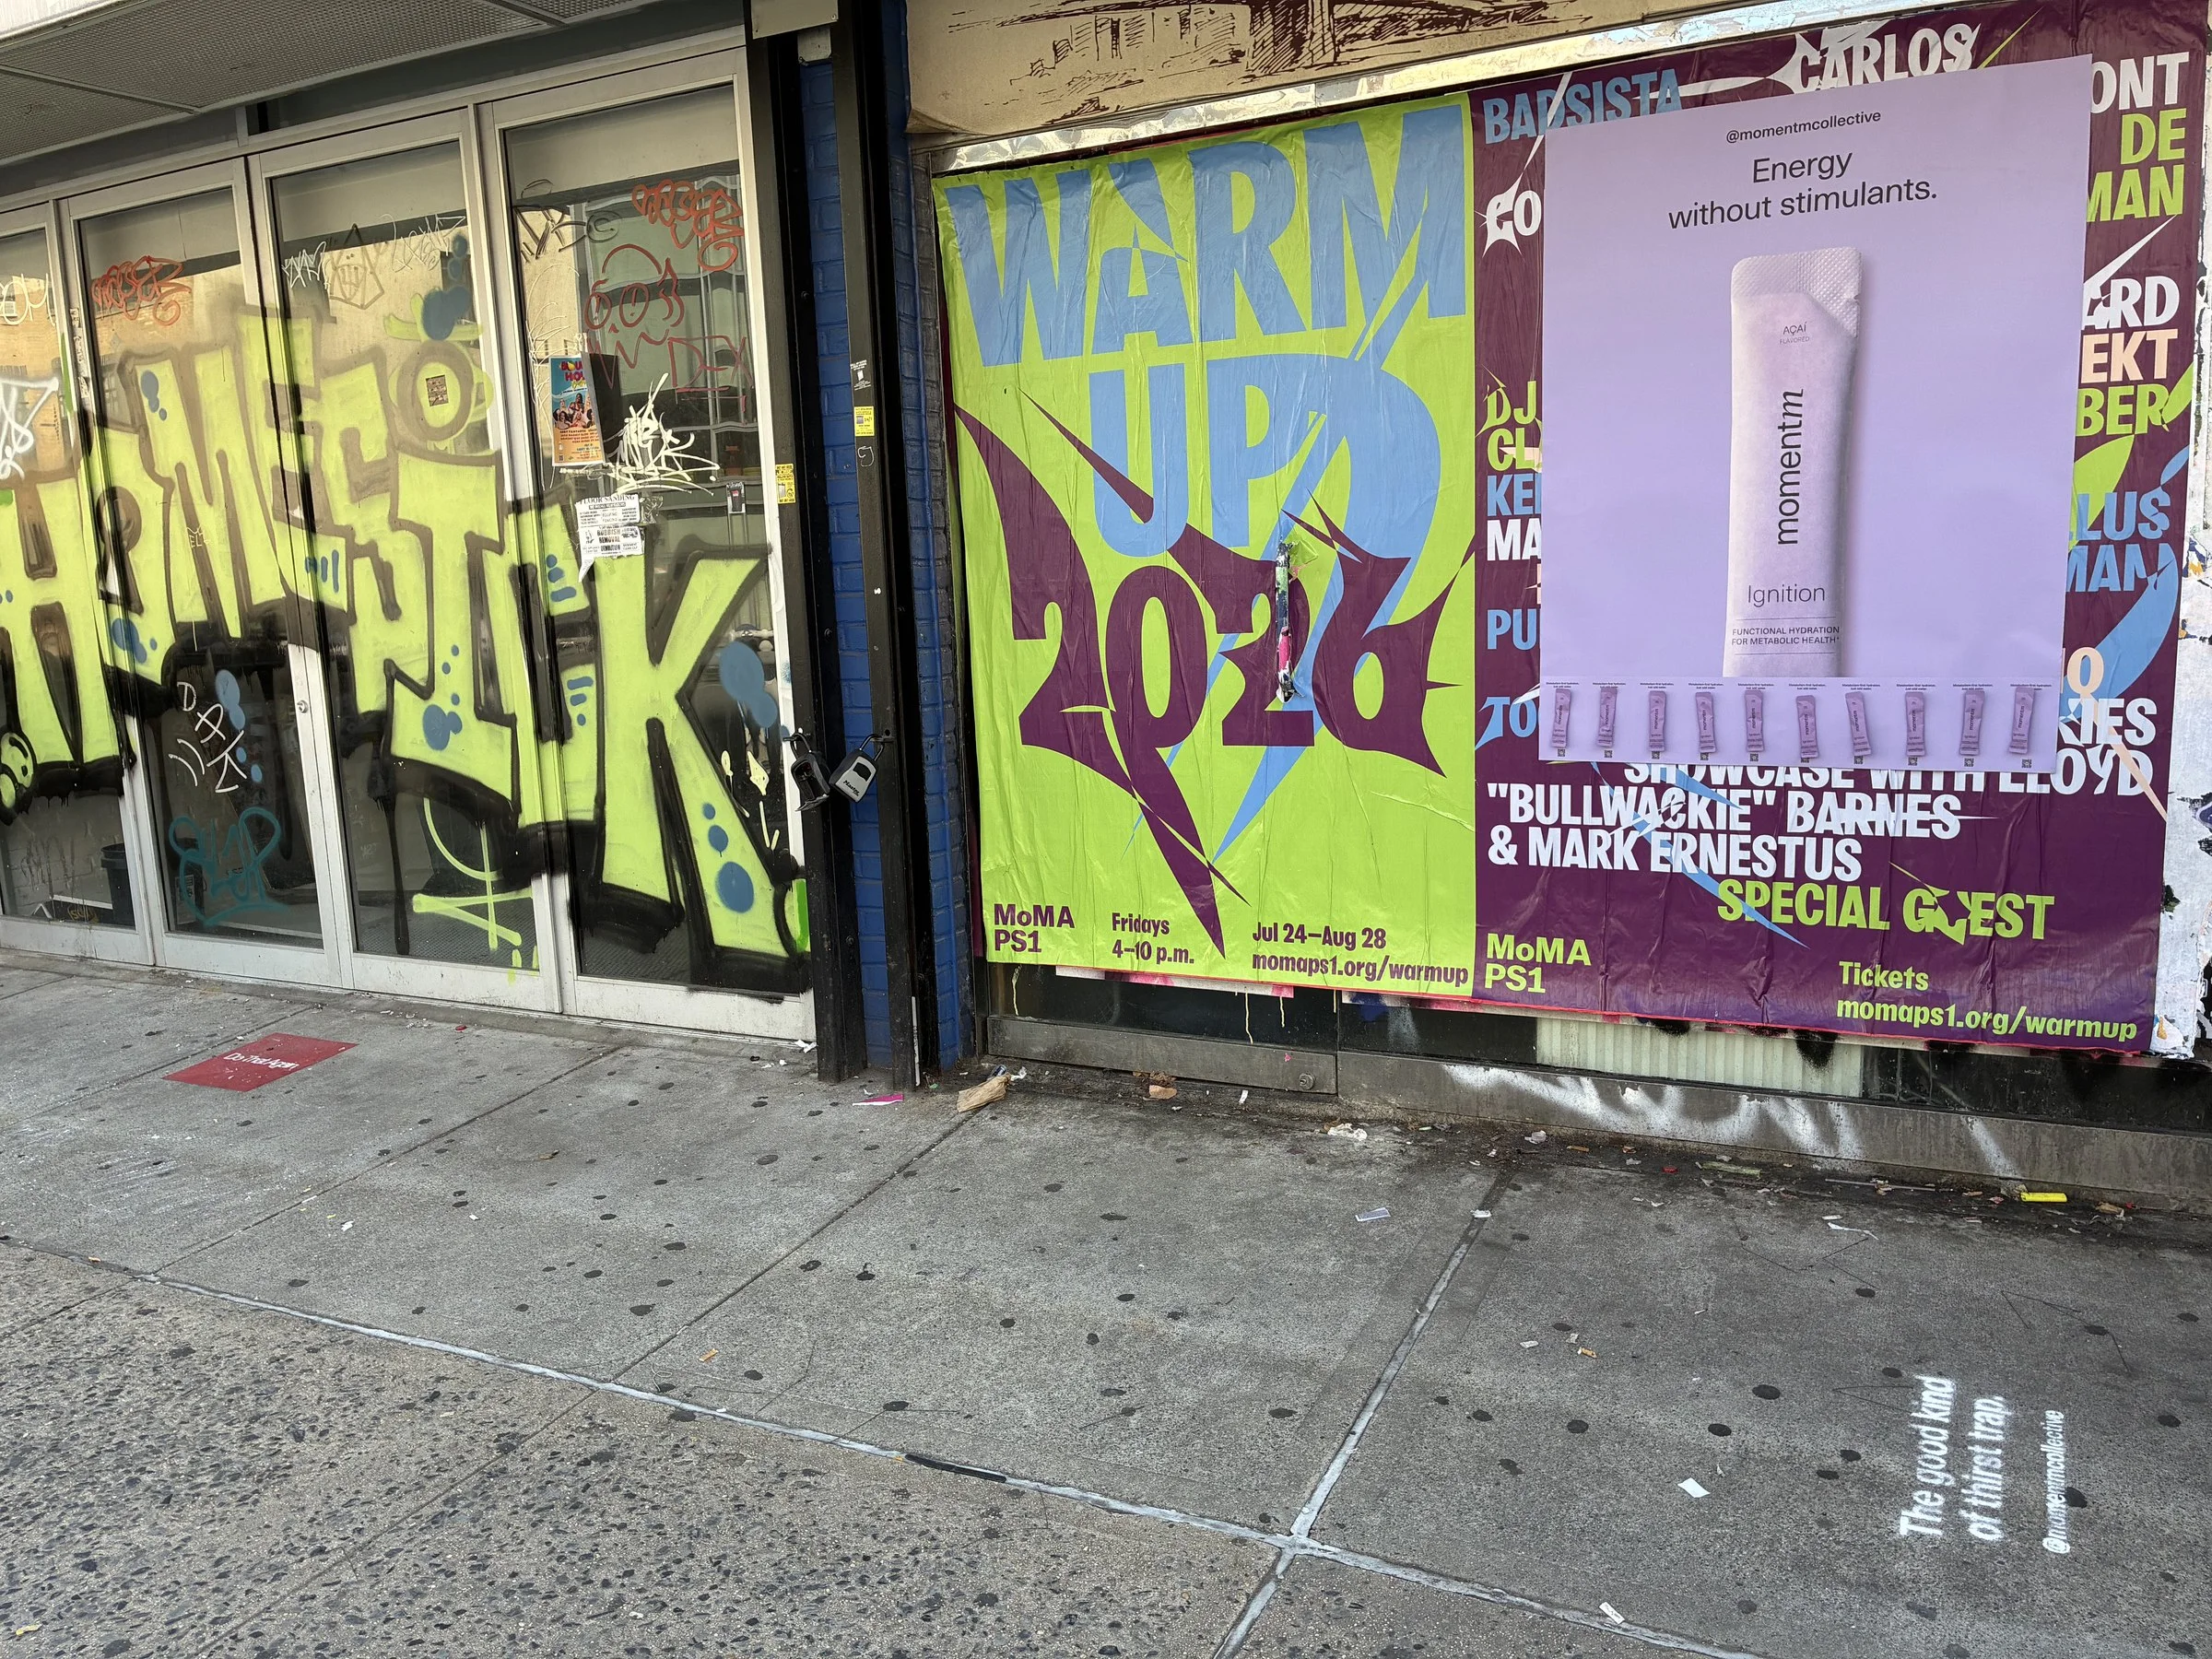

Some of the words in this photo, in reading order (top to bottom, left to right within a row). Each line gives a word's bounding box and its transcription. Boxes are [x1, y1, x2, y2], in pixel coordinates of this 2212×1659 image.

[1793, 21, 1981, 93] CARLOS
[1482, 68, 1683, 145] BADSISTA
[1726, 111, 1881, 144] @momentmcollective
[2121, 109, 2187, 165] DE
[1752, 150, 1853, 183] Energy
[1668, 196, 1771, 229] without
[1780, 178, 1937, 217] stimulants.
[944, 104, 1467, 368] WARM
[1779, 335, 1810, 345] FLAVORED
[1783, 322, 1806, 335] AÇAÍ
[1088, 353, 1441, 559] UP
[1777, 388, 1804, 546] momentm
[2069, 487, 2171, 541] LUS
[1747, 583, 1826, 608] Ignition
[1731, 638, 1748, 646] FOR
[1749, 637, 1799, 646] METABOLIC
[1732, 627, 1786, 636] FUNCTIONAL
[1788, 625, 1840, 635] HYDRATION
[1786, 790, 1961, 840] BARNES
[1487, 824, 1519, 866] &
[1528, 826, 1640, 871] MARK
[1650, 830, 1863, 883] ERNESTUS
[994, 903, 1075, 929] MoMA
[1717, 878, 1890, 931] SPECIAL
[994, 929, 1042, 954] PS1
[1112, 913, 1171, 936] Fridays
[1252, 922, 1279, 944] Jul
[1360, 927, 1387, 948] 28
[1157, 945, 1195, 964] p.m.
[1487, 933, 1592, 966] MoMA
[1252, 952, 1469, 987] momaps1.org/warmup
[1484, 963, 1547, 994] PS1
[1838, 961, 1930, 991] Tickets
[1836, 999, 2138, 1042] momaps1.org/warmup
[1910, 1373, 1956, 1424] kind
[1910, 1424, 1956, 1487] good
[1960, 1444, 2004, 1509] thirst
[1899, 1489, 1945, 1536] The
[1959, 1509, 2005, 1541] of
